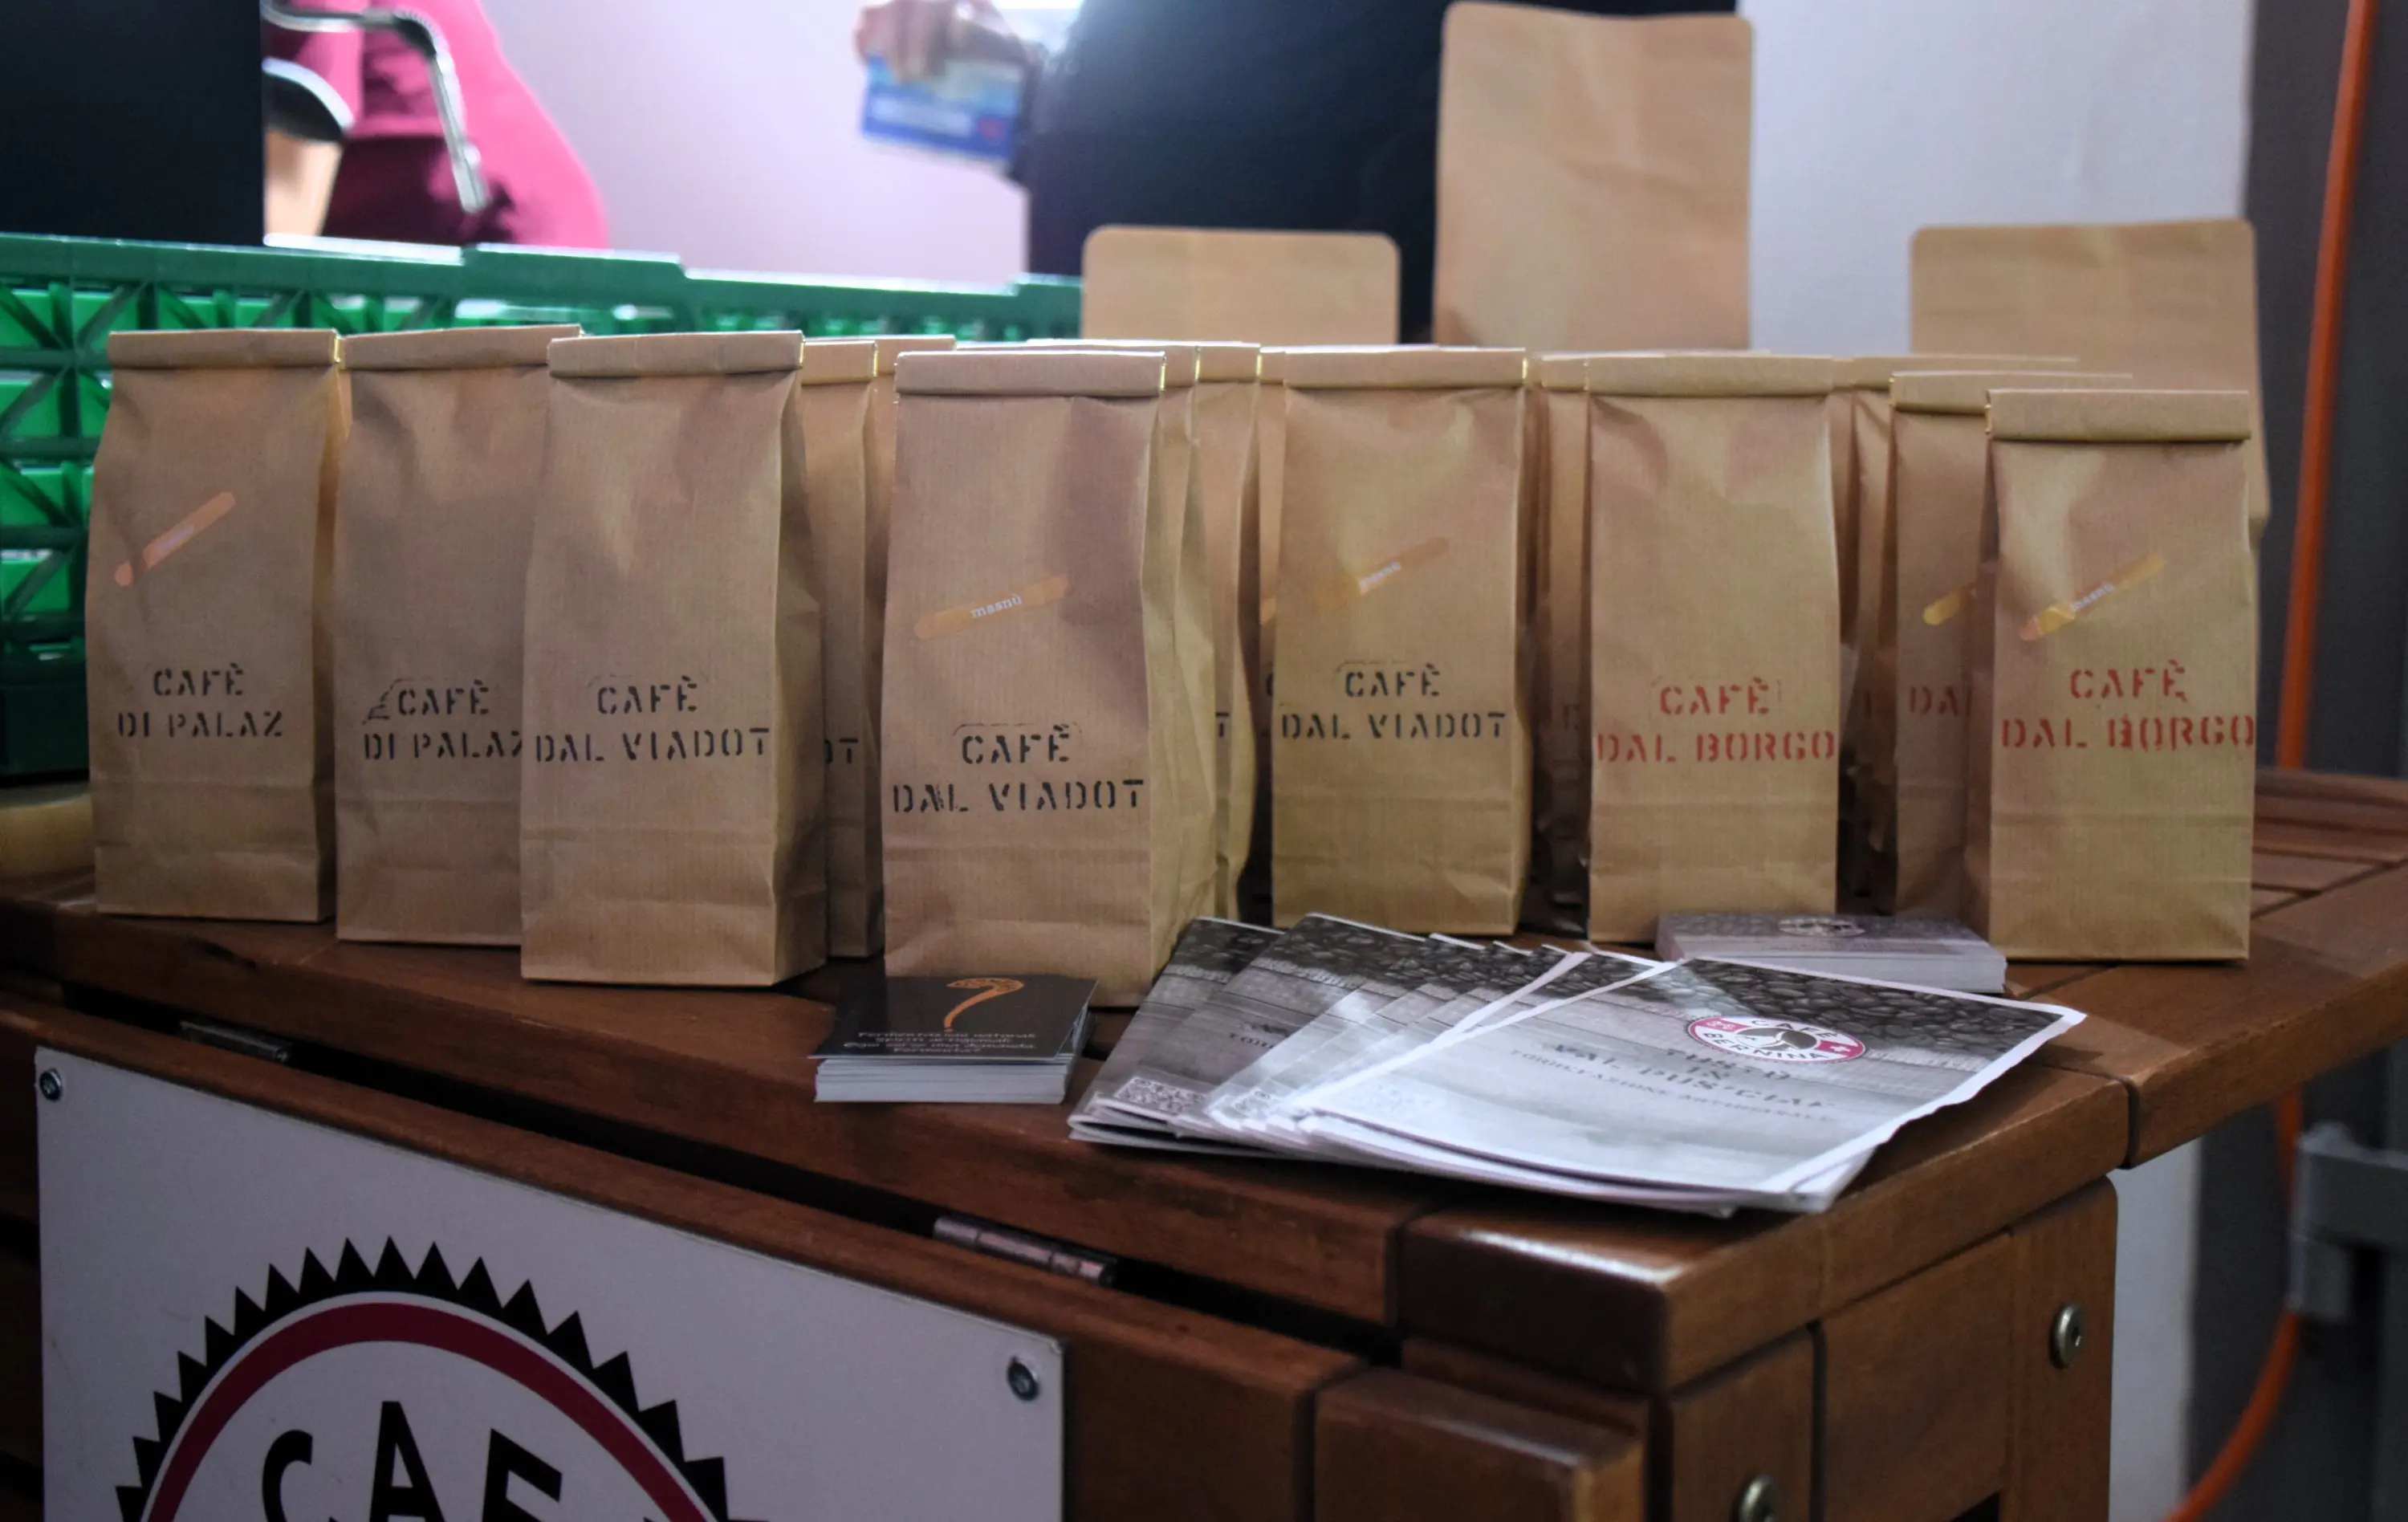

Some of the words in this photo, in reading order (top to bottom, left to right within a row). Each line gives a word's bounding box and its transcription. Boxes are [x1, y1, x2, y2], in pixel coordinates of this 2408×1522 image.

[153, 662, 244, 697] CAFÈ
[598, 675, 698, 714] CAFÈ
[1345, 663, 1440, 698] CAFÈ
[1659, 677, 1769, 715] CAFÈ
[2070, 659, 2186, 702] CAFÈ
[398, 679, 490, 716] CAFÈ
[118, 712, 150, 738] DI
[168, 710, 283, 739] PALAZ
[1282, 713, 1350, 739] DAL
[1369, 712, 1506, 739] VIADOT
[2002, 718, 2087, 750] DAL
[2108, 714, 2255, 751] BORGO
[364, 732, 395, 760] DI
[536, 734, 604, 762] DAL
[621, 727, 769, 760] VIADOT
[962, 724, 1070, 764] CAFÈ
[1597, 734, 1676, 762] DAL
[1696, 731, 1835, 762] BORGO
[893, 783, 968, 813] DAL
[989, 779, 1144, 811] VIADOT
[1703, 1032, 1828, 1060] BERNINA
[262, 1400, 655, 1522] CAF
